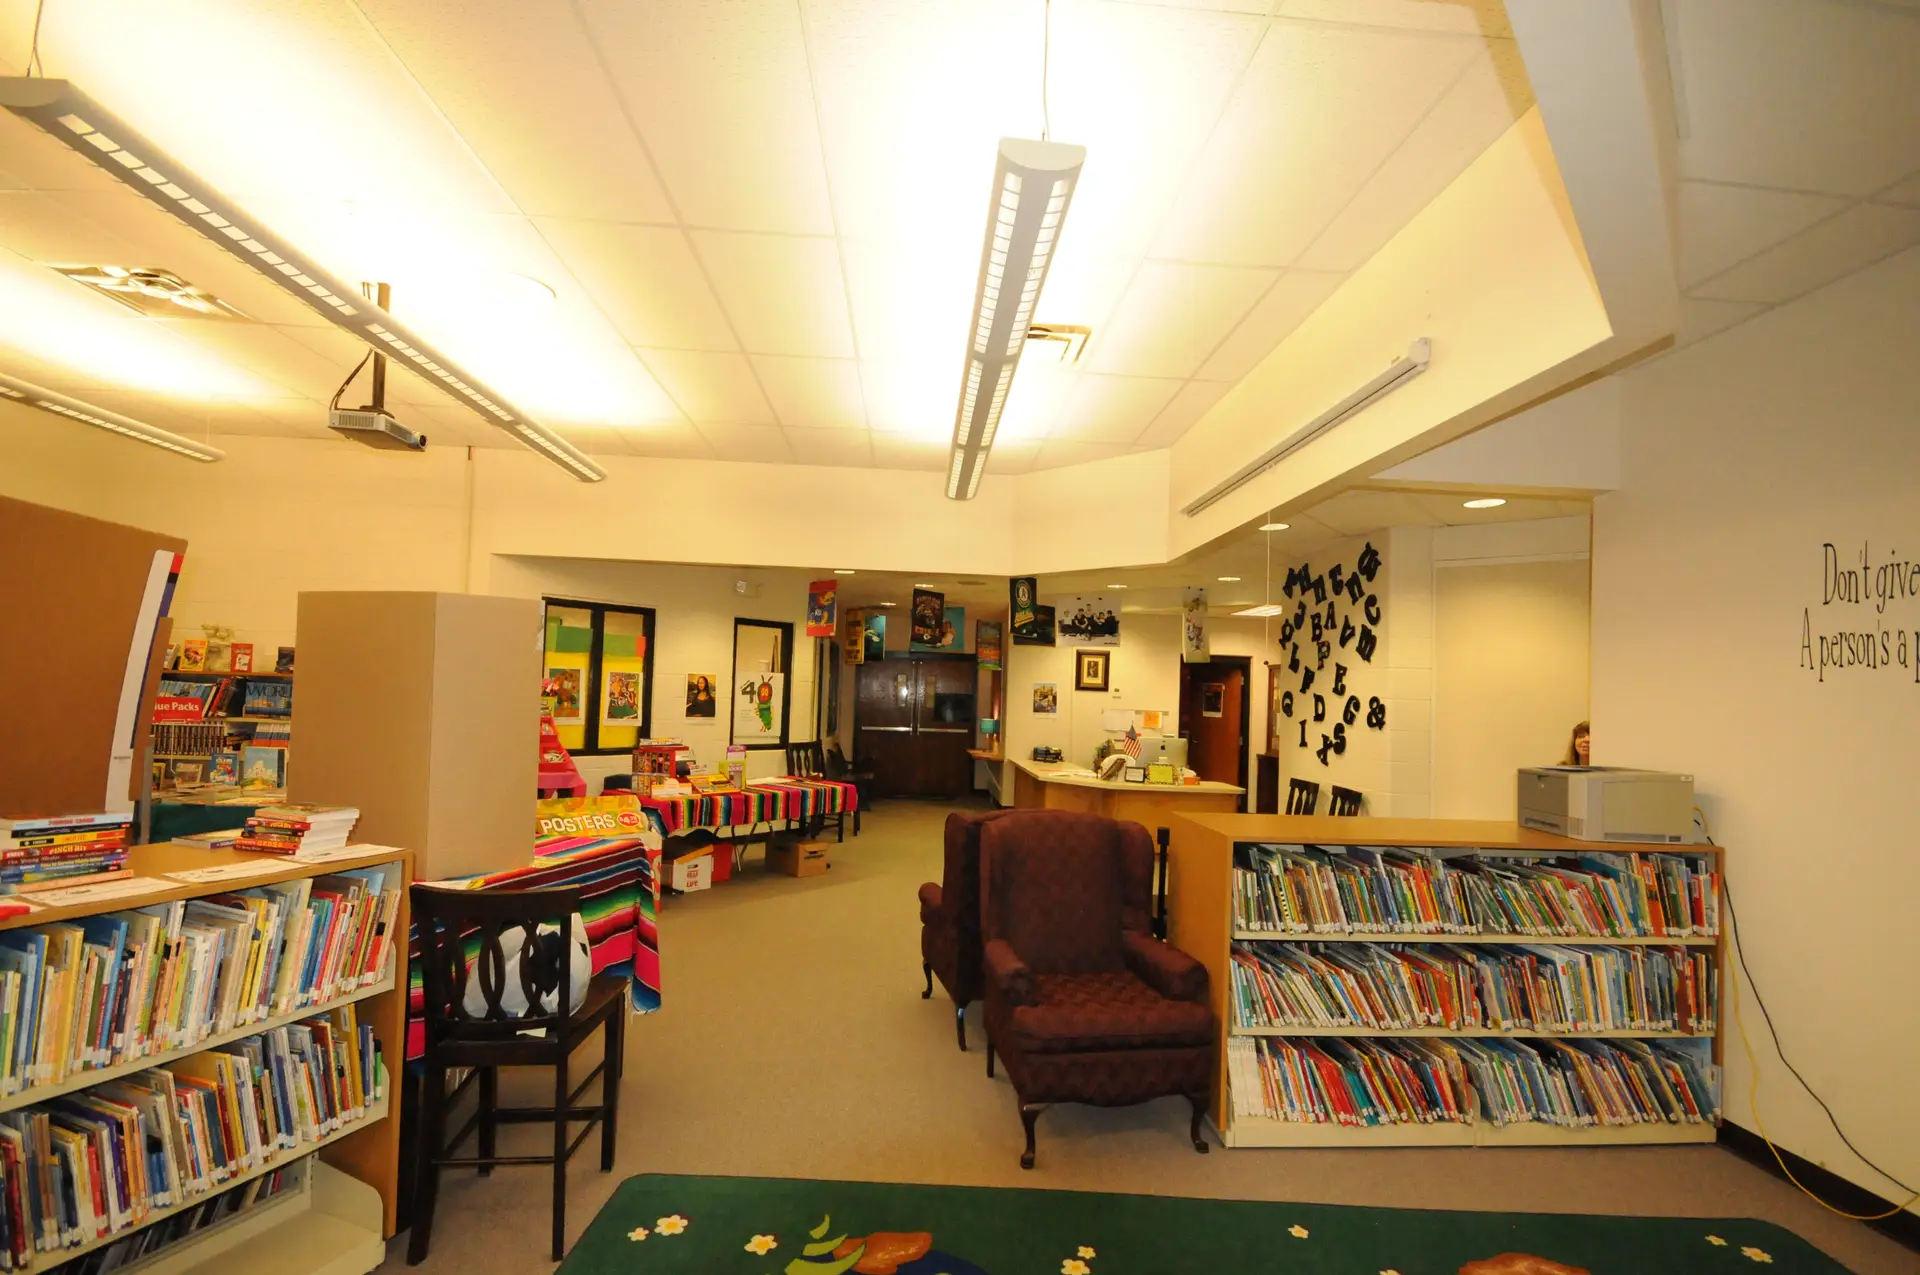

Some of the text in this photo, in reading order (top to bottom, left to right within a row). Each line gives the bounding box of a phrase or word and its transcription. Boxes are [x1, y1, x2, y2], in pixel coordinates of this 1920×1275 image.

[1823, 540, 1920, 614] Don't give
[1801, 607, 1814, 670] A
[1819, 619, 1890, 682] person's
[1898, 629, 1908, 668] a
[740, 680, 756, 704] 4
[172, 701, 199, 711] Packs
[540, 814, 616, 834] POSTERS
